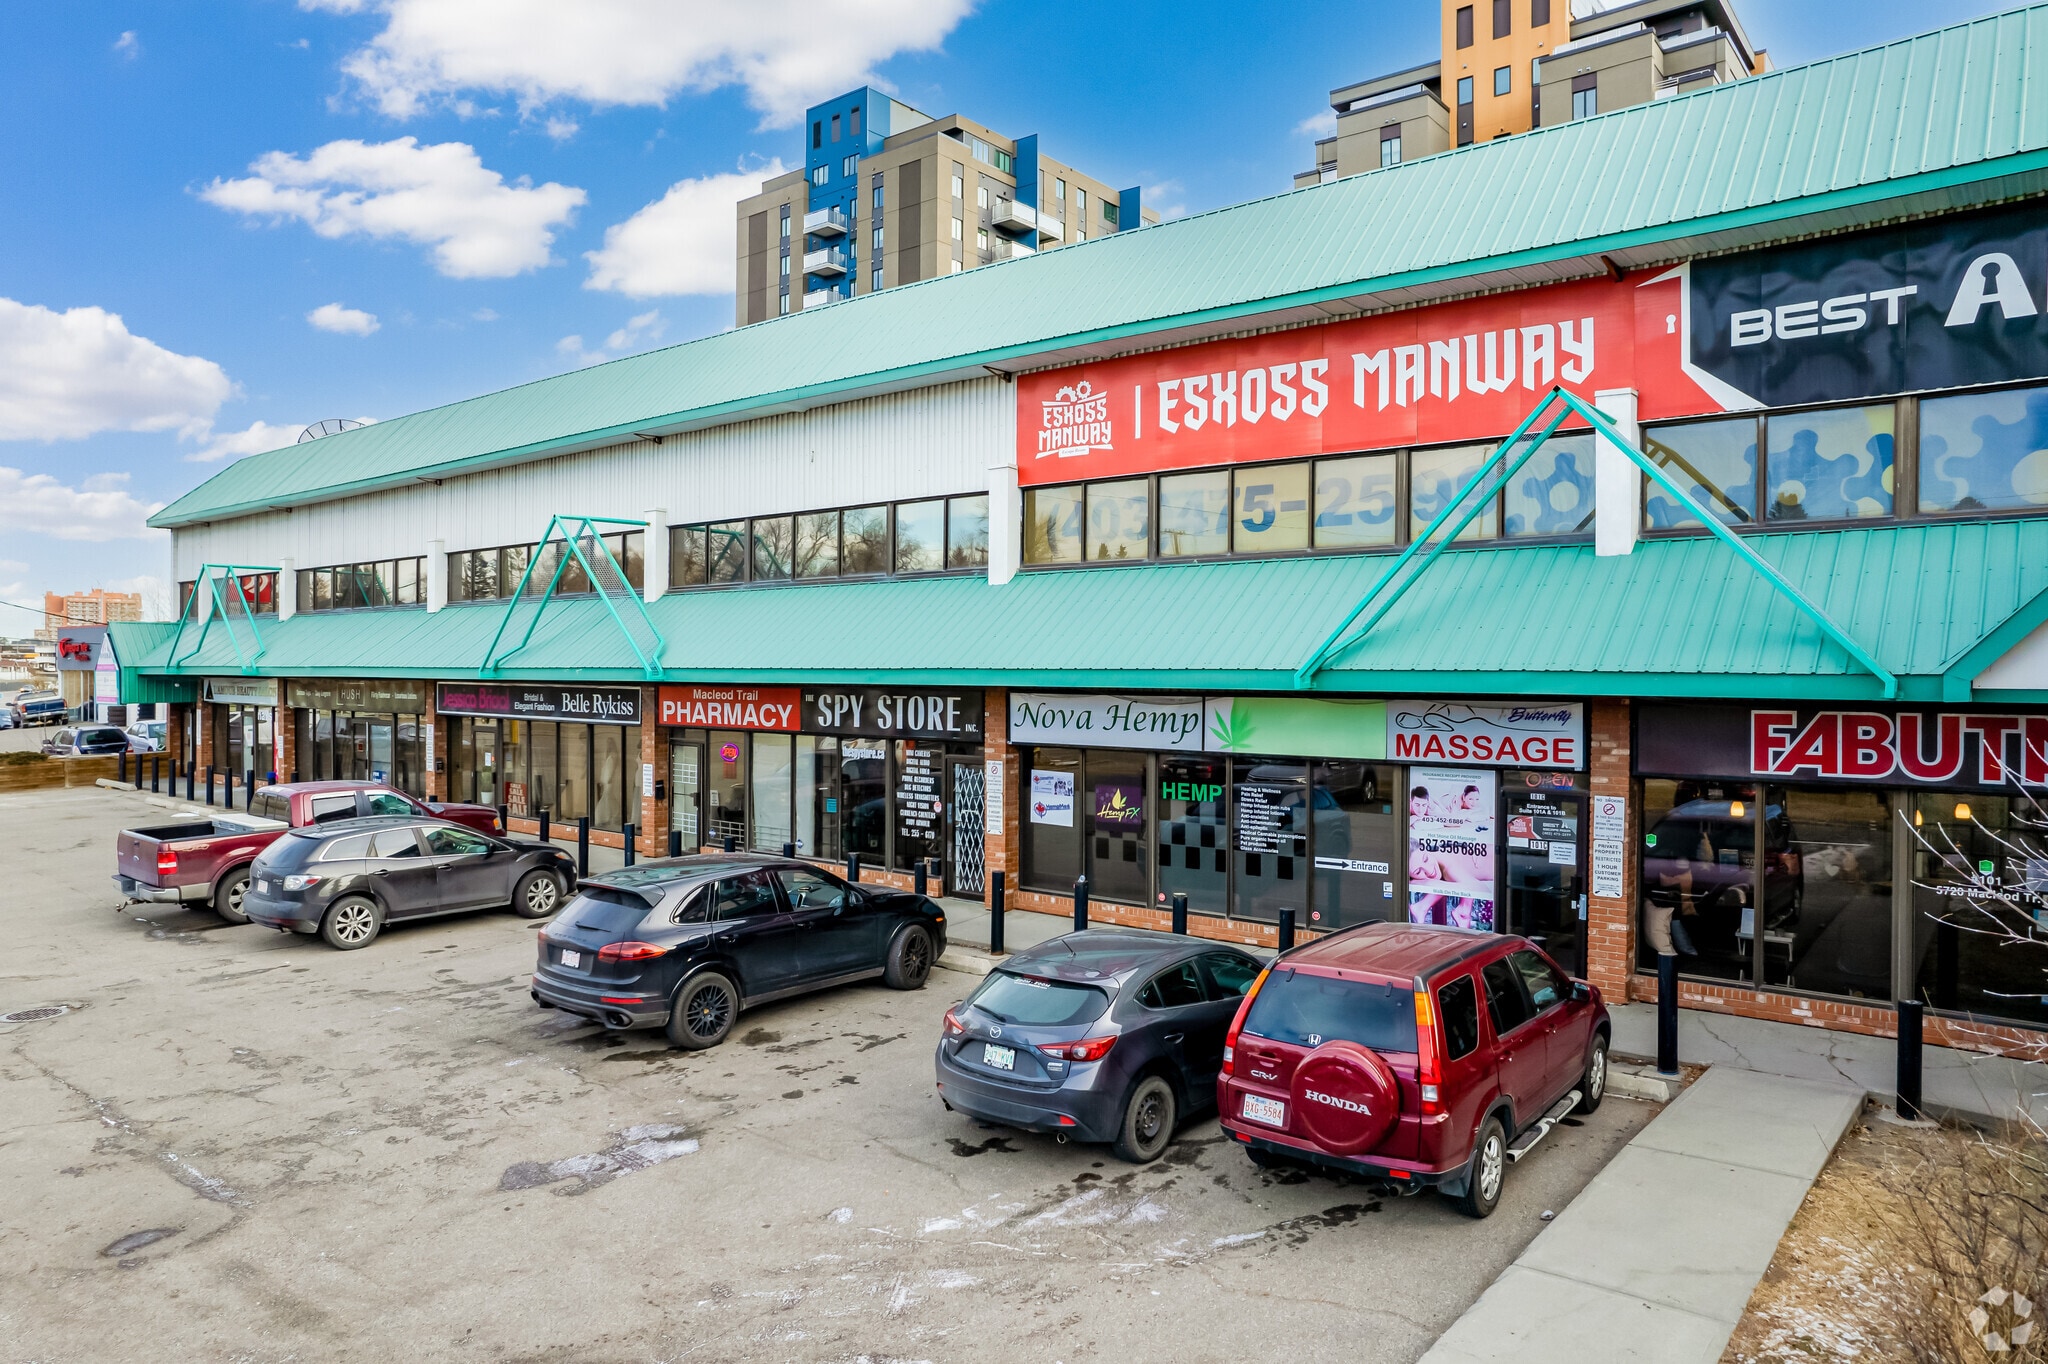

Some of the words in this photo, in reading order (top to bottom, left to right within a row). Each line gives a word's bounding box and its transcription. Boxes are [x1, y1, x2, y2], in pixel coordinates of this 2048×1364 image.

[1731, 284, 1917, 347] BEST
[1351, 316, 1595, 413] MANWAY
[1038, 420, 1112, 452] MANWAY
[341, 688, 361, 700] HUSH
[523, 692, 540, 702] Bridal
[693, 689, 733, 700] Macleod
[736, 690, 759, 701] Trail
[514, 701, 534, 712] Elegant
[534, 703, 556, 711] Fashion
[561, 692, 590, 713] Belle
[592, 693, 634, 719] Rykiss
[663, 700, 793, 728] PHARMACY
[817, 694, 864, 728] SPY
[877, 695, 962, 732] STORE
[965, 723, 979, 733] INC.
[1014, 702, 1094, 733] Nova
[1102, 700, 1200, 744] Hemp
[1507, 706, 1572, 727] Butterfly
[1395, 733, 1575, 764] MASSAGE
[1526, 771, 1575, 787] OPEN
[508, 794, 526, 805] SALE
[1162, 781, 1223, 803] HEMP
[507, 802, 528, 818] SALE
[1461, 841, 1488, 857] 6868
[1351, 861, 1388, 873] Entrance
[1595, 855, 1622, 863] RESTRICTED
[1250, 1070, 1278, 1081] CR-V
[1304, 1089, 1373, 1116] HONDA
